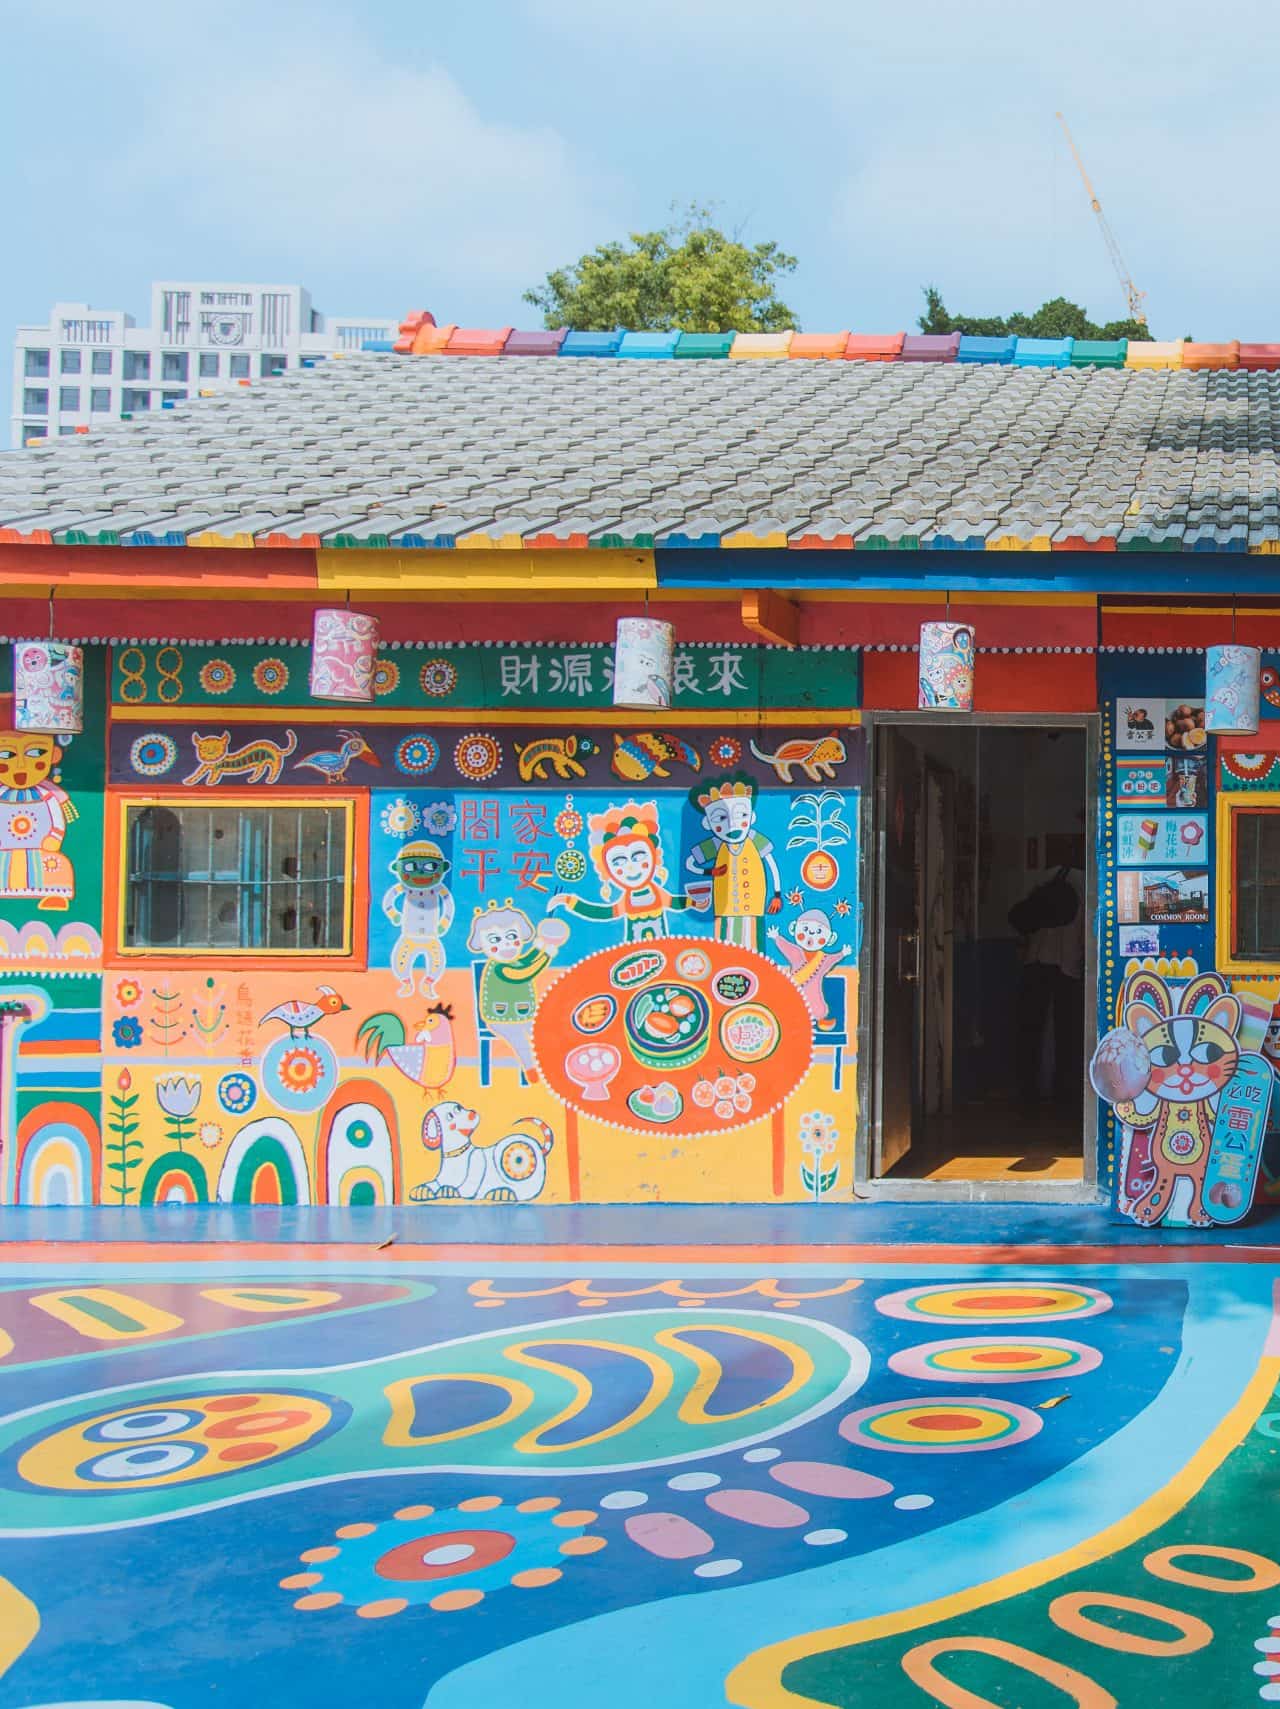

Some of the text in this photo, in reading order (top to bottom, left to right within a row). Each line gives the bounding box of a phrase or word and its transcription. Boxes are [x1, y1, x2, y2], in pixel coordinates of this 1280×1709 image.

[500, 652, 749, 697] 財源滾來
[461, 850, 553, 893] 平安
[1151, 912, 1206, 921] COMMON ROOM
[1227, 1086, 1263, 1103] 必吃
[1217, 1105, 1253, 1180] 雷公蛋
